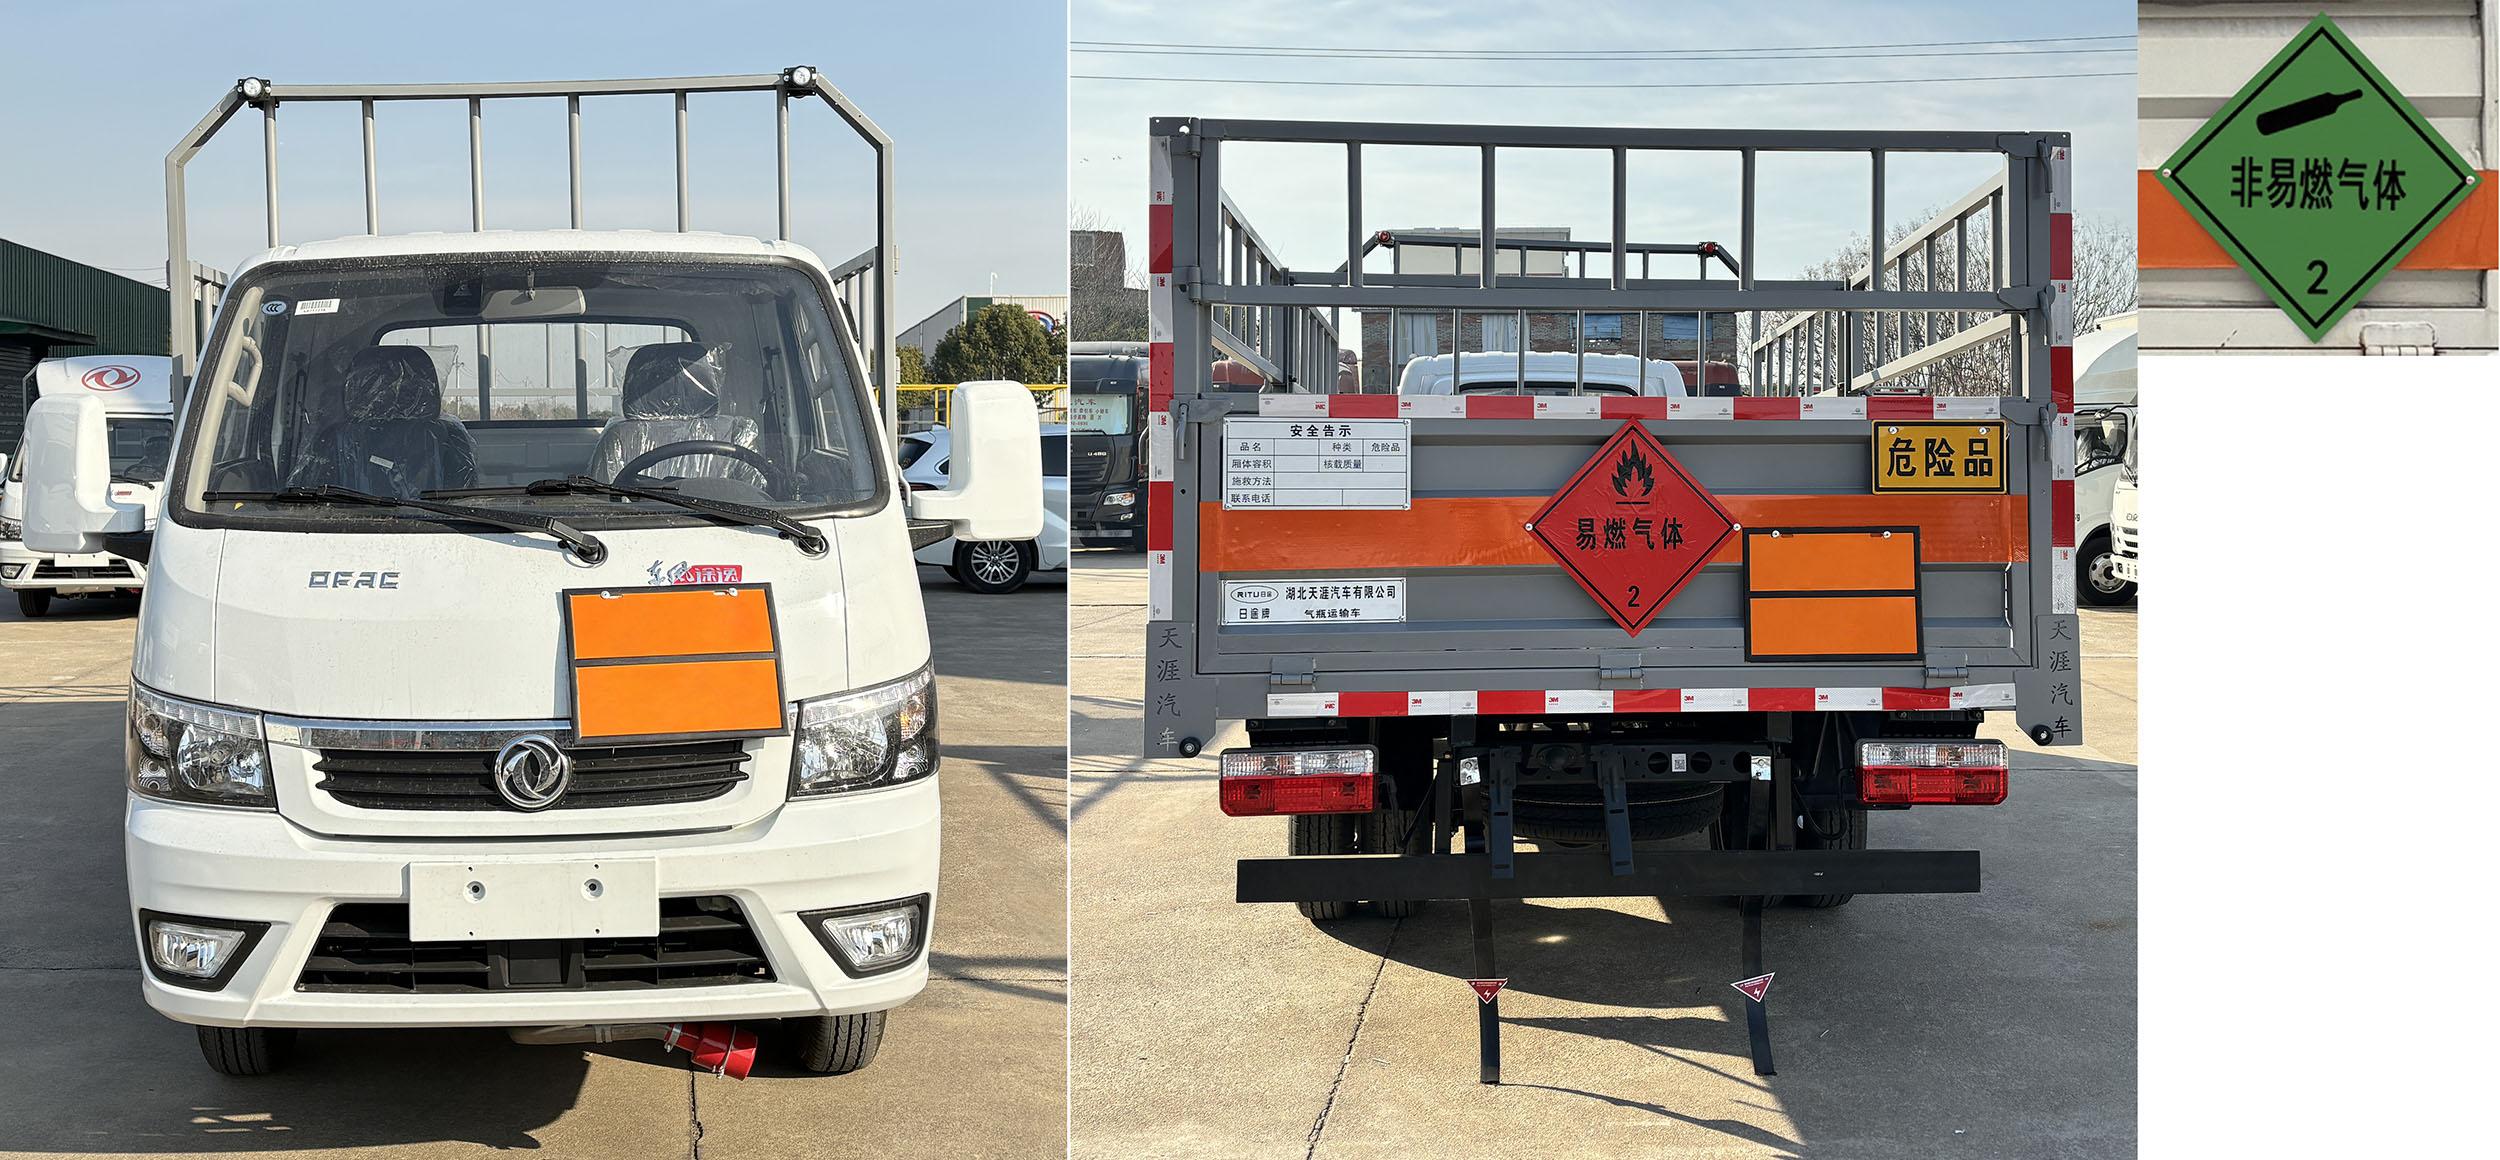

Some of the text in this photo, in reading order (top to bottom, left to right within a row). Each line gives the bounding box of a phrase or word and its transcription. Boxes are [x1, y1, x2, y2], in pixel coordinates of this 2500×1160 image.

[2230, 156, 2407, 211] 非易燃气体
[2307, 260, 2328, 295] 2
[1290, 424, 1352, 437] 安全告示
[1240, 442, 1262, 452] 品名
[1332, 442, 1352, 452] 种类
[1371, 442, 1400, 452] 危险品
[1231, 459, 1272, 469] 厢体容积
[1886, 437, 1993, 478] 危险品
[1323, 459, 1362, 470] 核载质量
[1231, 476, 1272, 486] 施救方法
[1231, 493, 1271, 503] 联系电话
[1576, 517, 1684, 551] 易燃气体
[1285, 585, 1397, 601] 湖北天涯汽车有限公司
[1627, 585, 1640, 608] 2
[1239, 607, 1271, 620] 日途牌
[1304, 608, 1361, 620] 气瓶运输车
[2049, 620, 2073, 738] 天涯汽车
[1157, 627, 1182, 752] 天涯汽车
